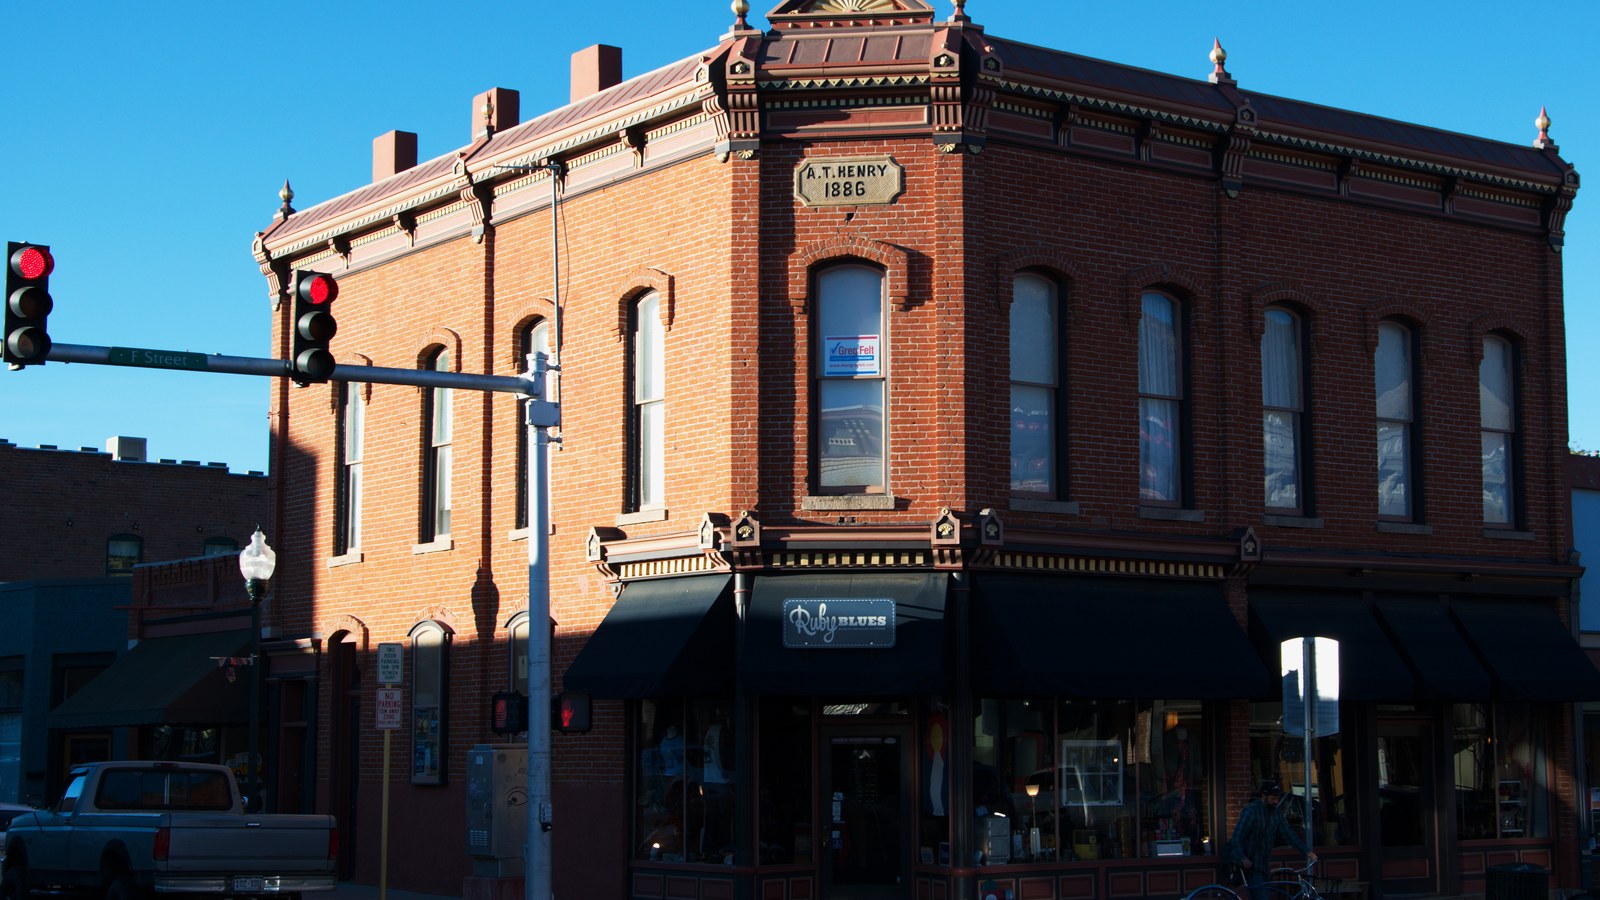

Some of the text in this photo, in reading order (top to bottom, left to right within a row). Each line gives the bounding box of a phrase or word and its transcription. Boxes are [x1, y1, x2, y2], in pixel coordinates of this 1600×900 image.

[825, 181, 865, 198] 1886
[131, 350, 188, 366] F Street
[838, 346, 874, 356] Greg Felt
[789, 602, 886, 643] Ruby BLUES
[385, 692, 394, 700] NO
